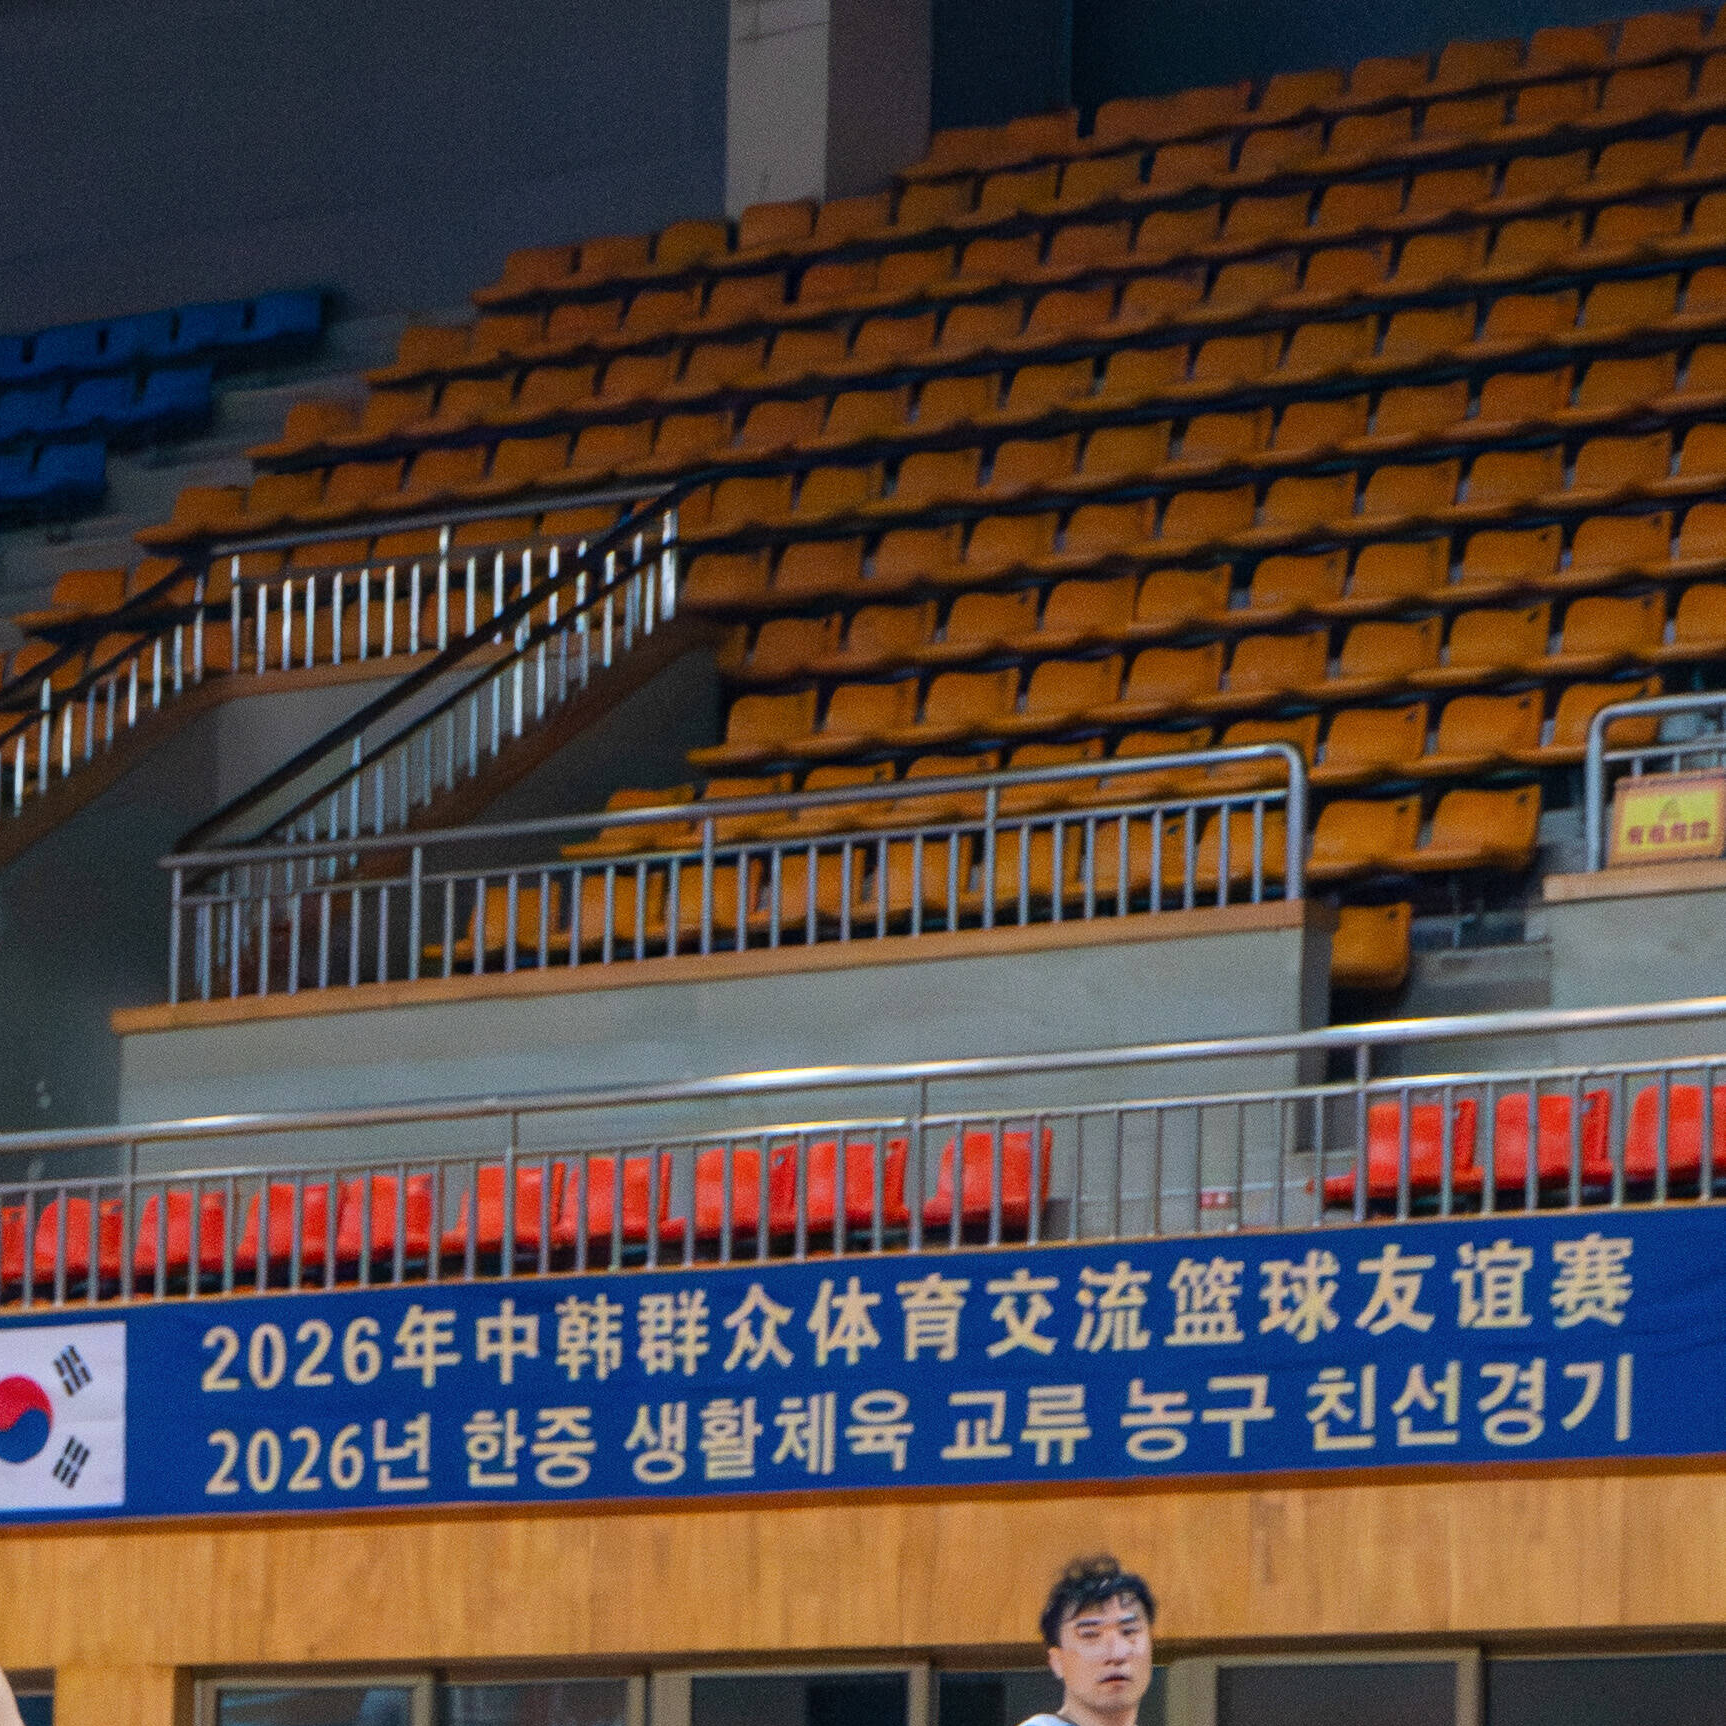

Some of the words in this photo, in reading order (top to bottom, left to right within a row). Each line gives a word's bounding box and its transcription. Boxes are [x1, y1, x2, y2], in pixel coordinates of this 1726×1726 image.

[202, 1233, 1636, 1393] 2026年中韩群众体育交流篮球友谊赛
[206, 1411, 432, 1496] 2026년
[462, 1405, 597, 1489] 한중
[624, 1390, 916, 1484] 생활체육
[940, 1383, 1092, 1465] 교류
[1120, 1372, 1275, 1461] 농구
[1306, 1353, 1634, 1451] 친선경기
